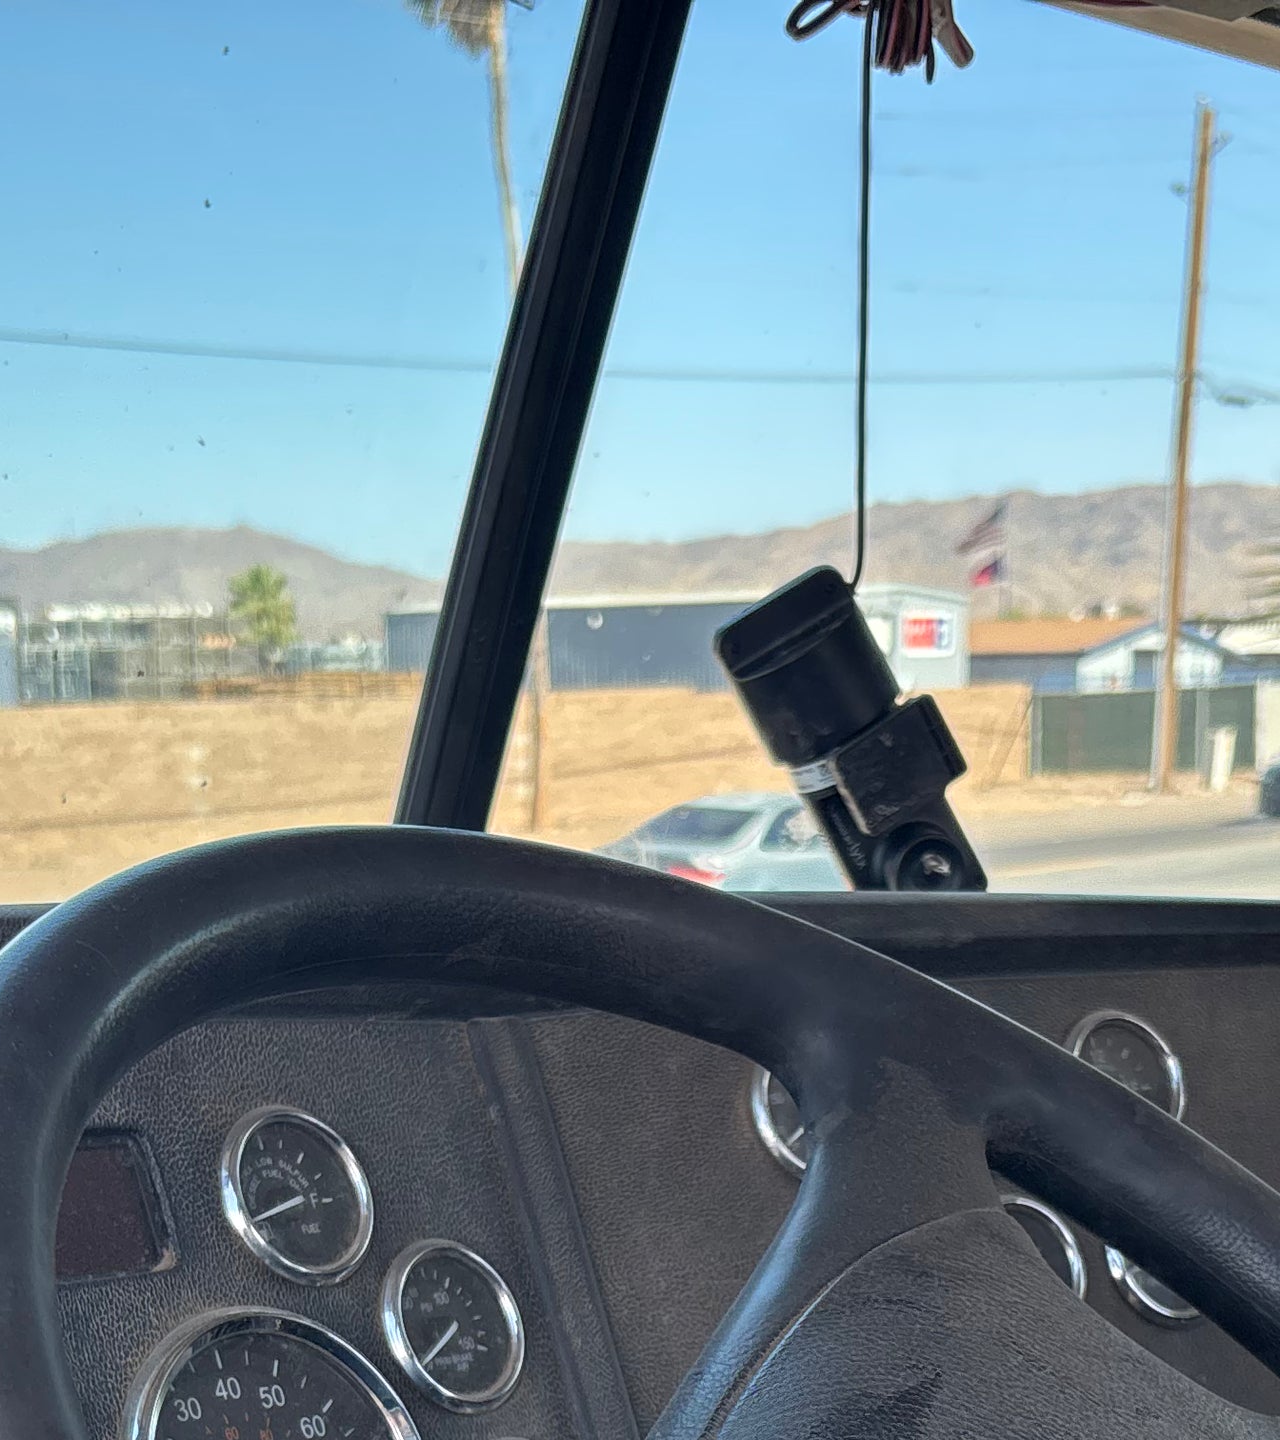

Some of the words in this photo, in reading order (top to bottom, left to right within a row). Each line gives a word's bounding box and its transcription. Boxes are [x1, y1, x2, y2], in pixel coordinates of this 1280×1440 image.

[215, 1377, 241, 1401] 40
[259, 1384, 286, 1410] 50
[174, 1396, 202, 1422] 30
[224, 1426, 240, 1440] 60
[300, 1415, 327, 1440] 60
